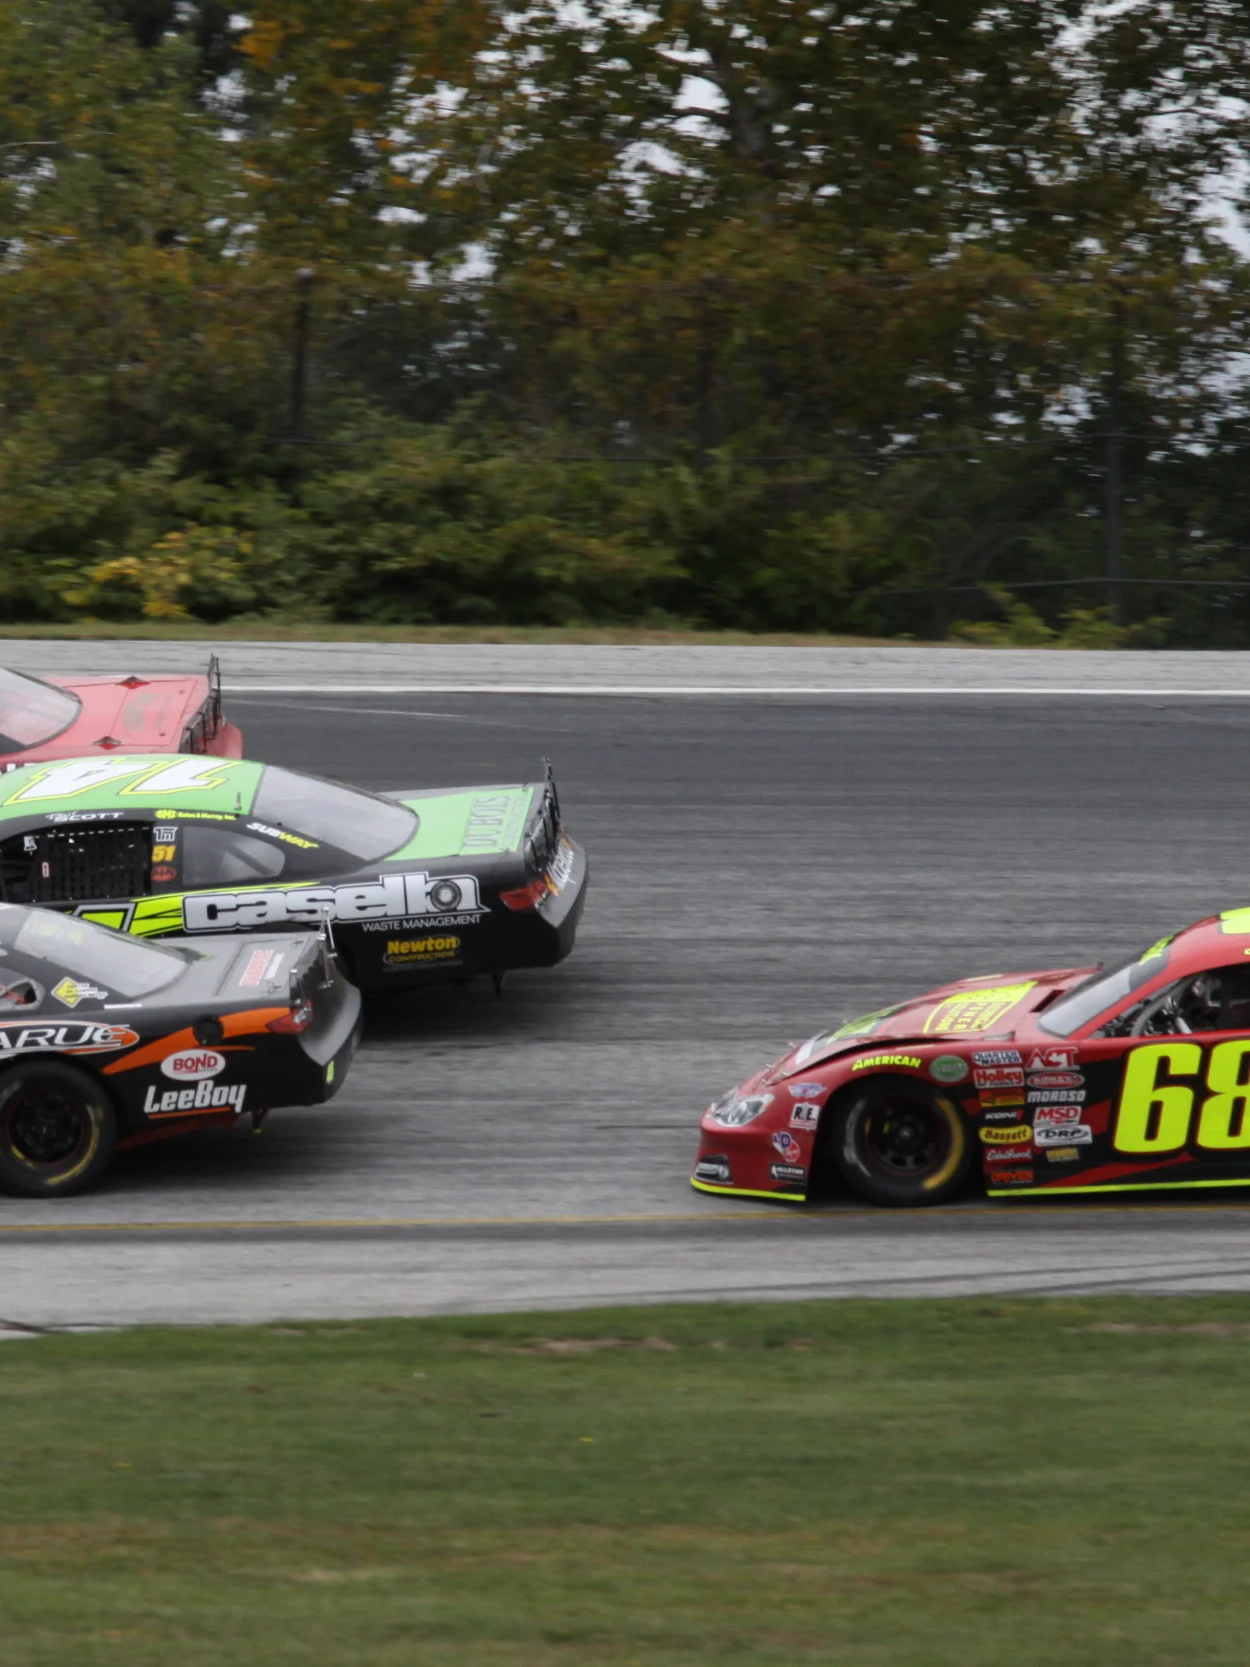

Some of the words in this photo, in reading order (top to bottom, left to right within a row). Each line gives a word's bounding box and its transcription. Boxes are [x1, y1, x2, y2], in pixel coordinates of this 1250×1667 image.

[247, 822, 319, 849] SUBWAY
[152, 845, 176, 862] 51
[362, 921, 401, 932] WASTE
[403, 914, 481, 929] MANAGEMENT
[387, 937, 457, 955] Newton
[173, 1053, 218, 1073] BOND
[852, 1055, 922, 1071] AMERICAN
[144, 1080, 246, 1113] LeeBoy
[1027, 1091, 1086, 1102] MOROSO
[1113, 1040, 1250, 1155] 68
[1036, 1107, 1078, 1120] MSD
[985, 1130, 1027, 1141] Bassett
[1045, 1130, 1082, 1139] DRP
